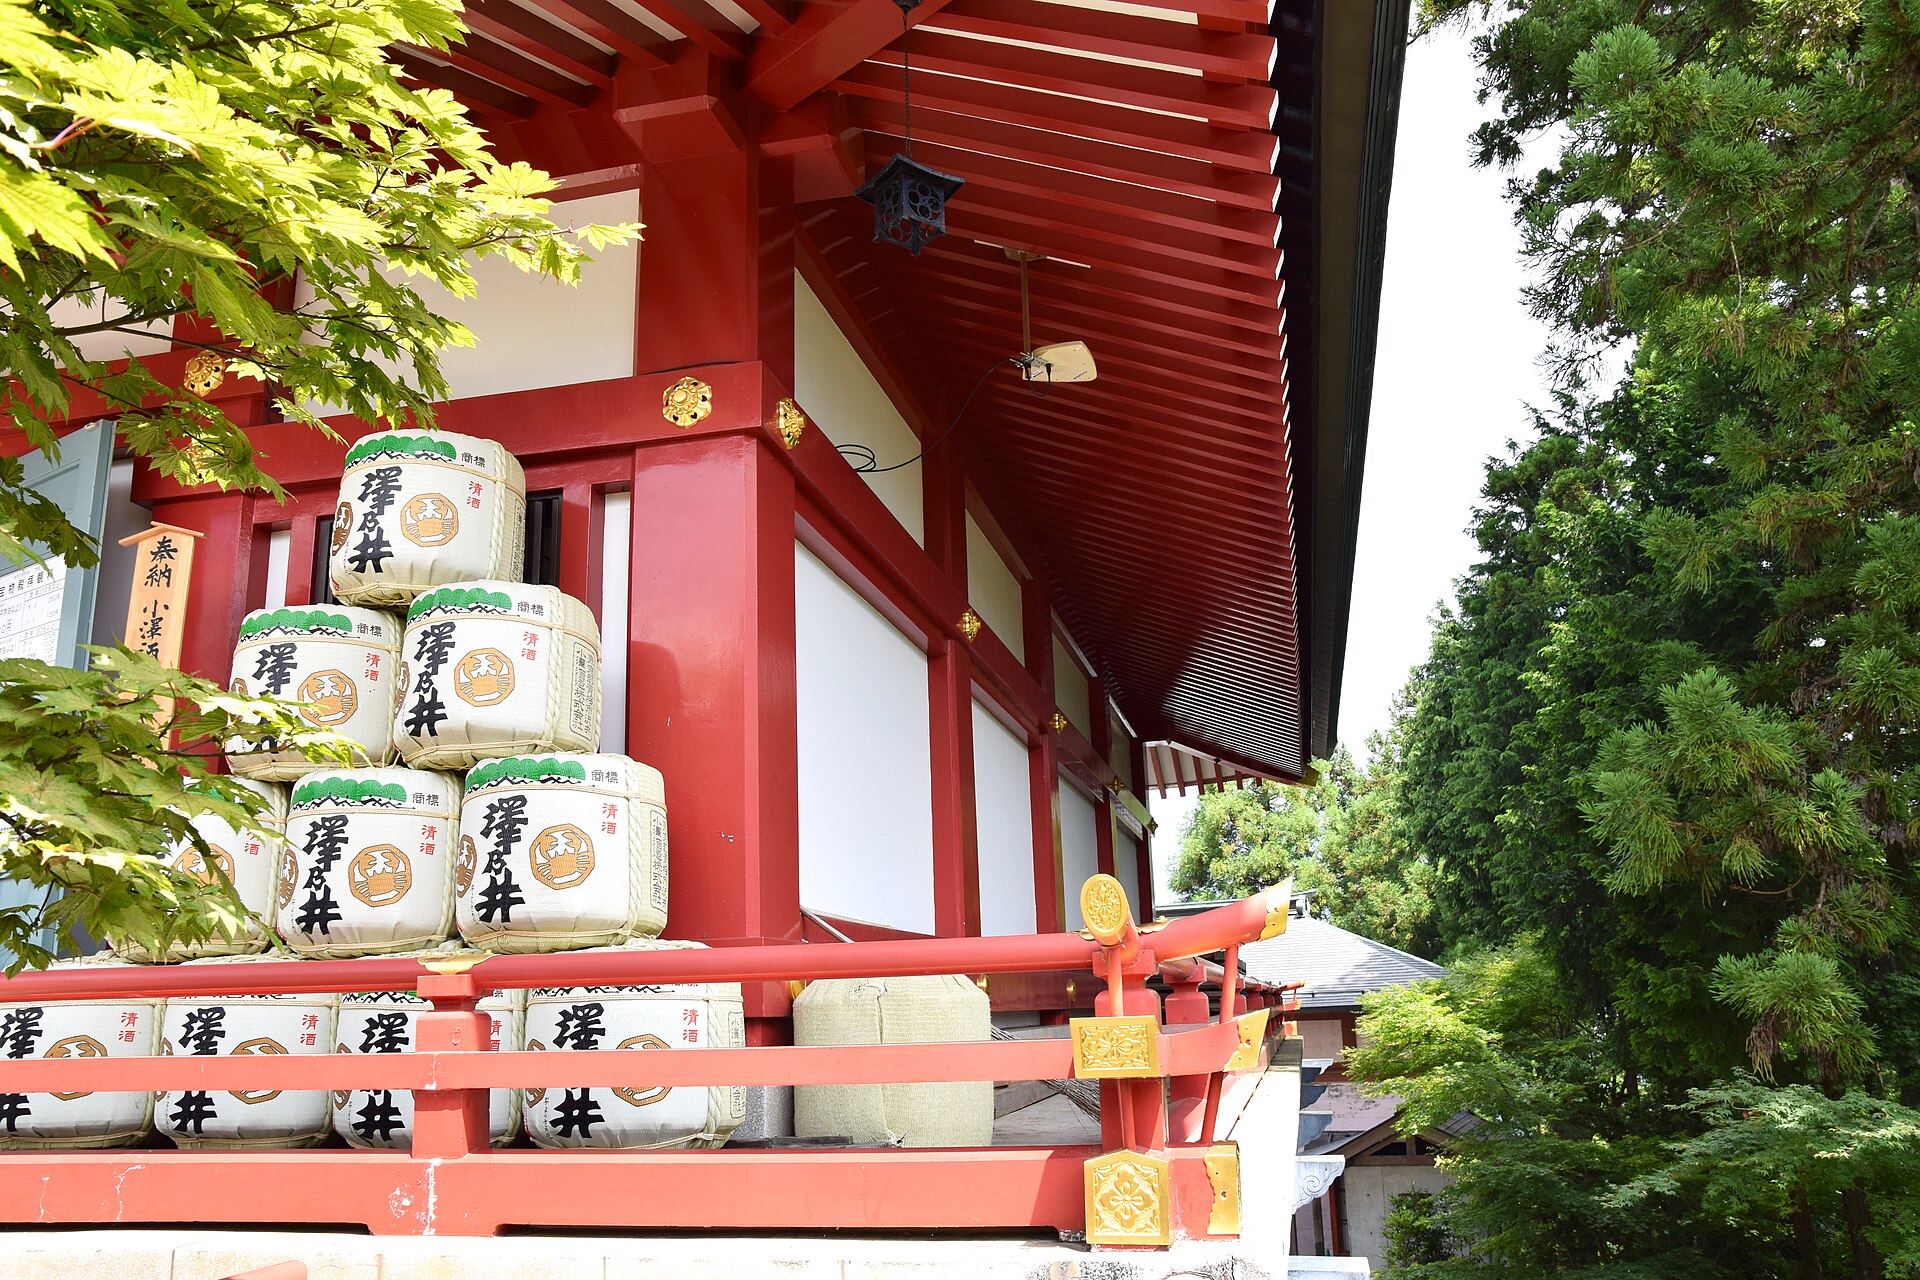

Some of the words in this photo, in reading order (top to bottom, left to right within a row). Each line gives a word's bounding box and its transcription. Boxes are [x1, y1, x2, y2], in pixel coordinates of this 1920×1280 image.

[461, 452, 487, 468] 商標
[467, 481, 484, 510] 清酒
[144, 535, 178, 588] 奉納
[517, 601, 544, 617] 商標
[356, 623, 383, 638] 商標
[521, 631, 540, 661] 清酒
[364, 652, 381, 682] 清酒
[591, 769, 619, 784] 商標
[412, 792, 440, 807] 商標
[601, 802, 618, 835] 清酒
[420, 824, 438, 856] 清酒
[118, 1012, 139, 1043] 清酒
[300, 1014, 320, 1046] 清酒
[683, 1008, 699, 1043] 清酒
